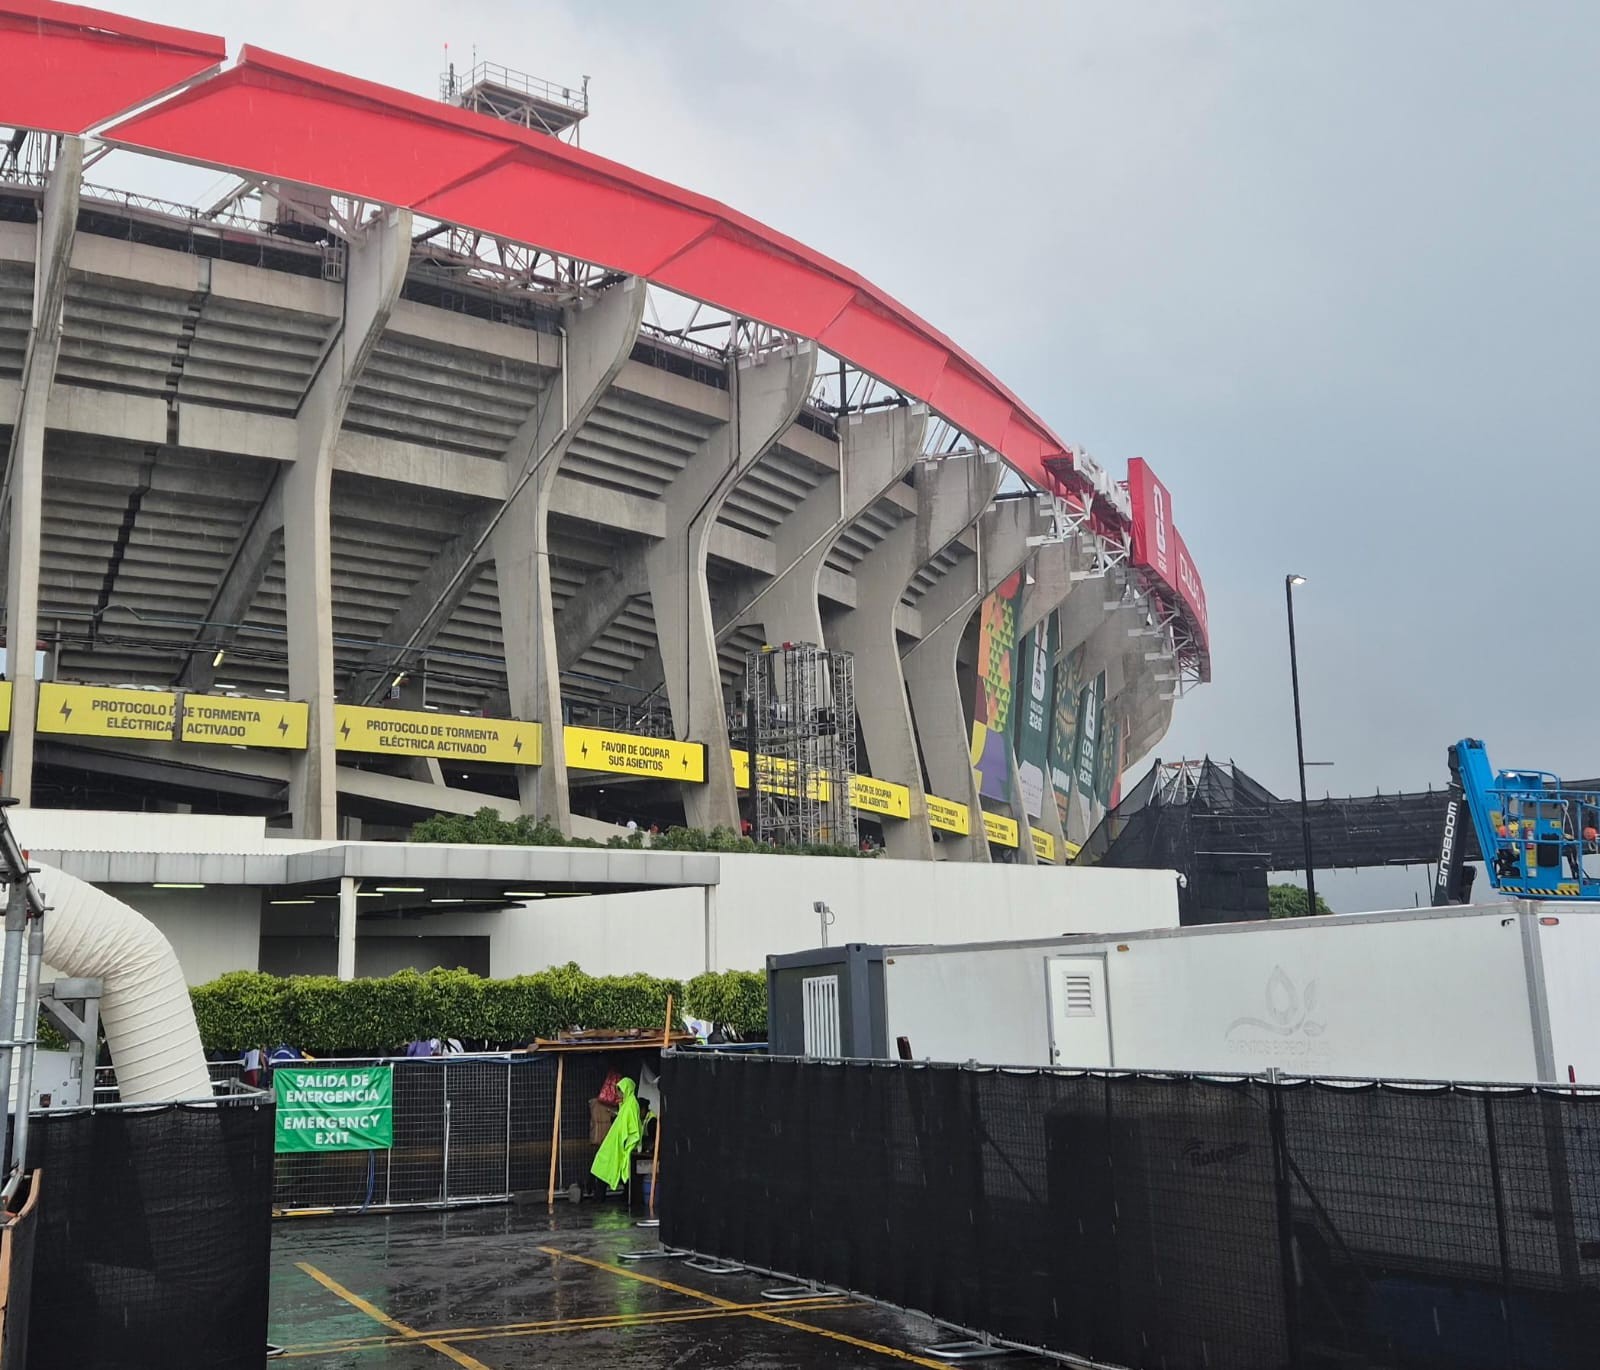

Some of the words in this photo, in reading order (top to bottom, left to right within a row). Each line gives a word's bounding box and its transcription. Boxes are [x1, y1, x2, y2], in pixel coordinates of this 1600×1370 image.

[92, 699, 167, 716] PROTOCOLO
[197, 707, 261, 722] TORMENTA
[107, 716, 174, 732] ELÉCTRICA
[186, 722, 246, 737] ACTIVADO
[366, 719, 429, 735] PROTOCOLO
[430, 725, 443, 736] DE
[445, 726, 499, 741] TORMENTA
[379, 735, 435, 750] ELÉCTRICA
[437, 740, 487, 754] ACTIVADO
[601, 741, 627, 754] FAVOR
[628, 744, 638, 755] DE
[639, 745, 670, 759] OCUPAR
[608, 755, 625, 767] SUS
[626, 757, 664, 771] ASIENTOS
[1438, 801, 1458, 887] SINOBOOM
[296, 1074, 348, 1088] SALIDA
[351, 1073, 369, 1086] DE
[286, 1089, 380, 1103] EMERGENCIA
[284, 1114, 380, 1129] EMERGENCY
[315, 1132, 350, 1144] EXIT
